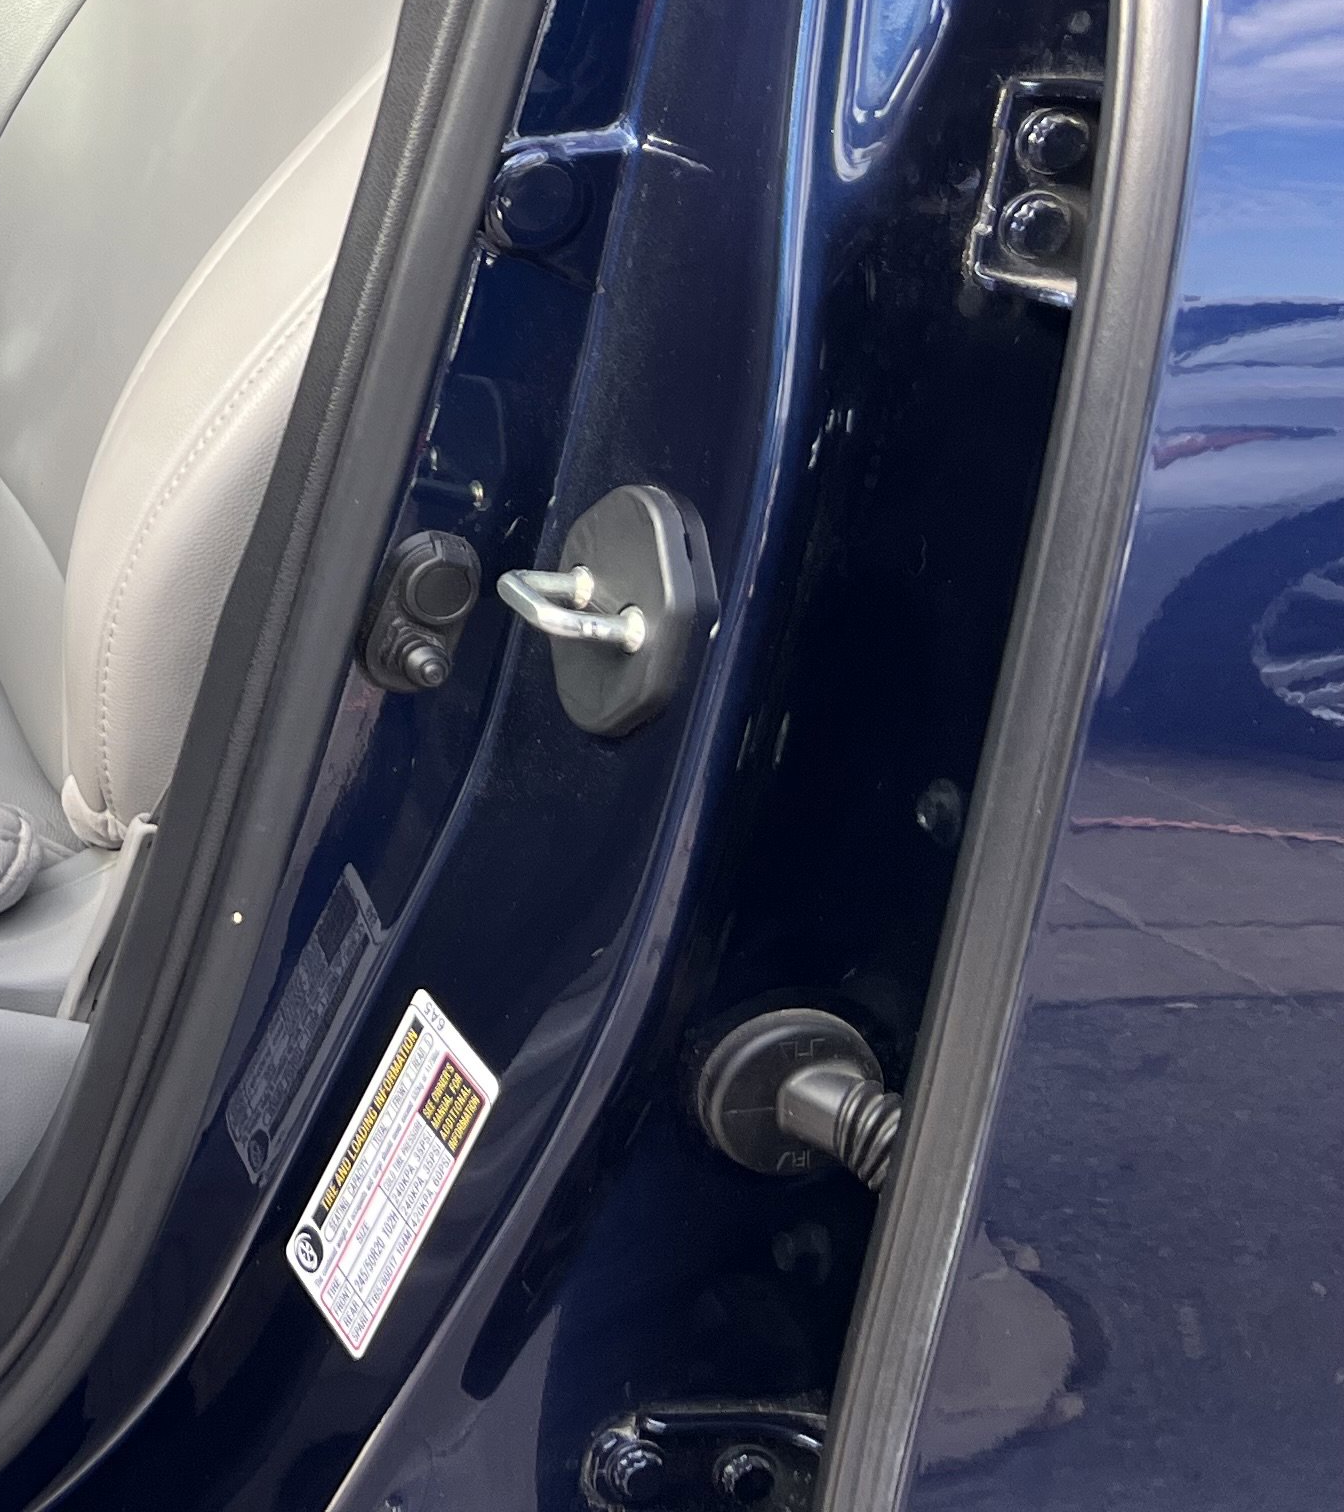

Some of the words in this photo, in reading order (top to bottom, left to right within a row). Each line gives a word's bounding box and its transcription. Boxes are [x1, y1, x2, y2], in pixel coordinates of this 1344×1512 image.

[320, 1179, 339, 1213] TIRE
[333, 1154, 352, 1188] AND
[346, 1103, 378, 1161] LOADING
[372, 1025, 418, 1110] INFORMATION
[421, 1098, 436, 1120] SEE
[430, 1061, 455, 1104] OWNER'S
[430, 1090, 453, 1130] MANUAL
[448, 1072, 463, 1094] FOR
[439, 1082, 471, 1141] ADDITIONAL
[447, 1093, 481, 1152] INFORMATION
[328, 1195, 349, 1233] SEATING
[346, 1155, 370, 1197] CAPACITY
[372, 1121, 387, 1146] TOTAL
[391, 1081, 408, 1109] FRONT
[411, 1045, 426, 1070] REAR
[326, 1274, 341, 1300] TIRE
[355, 1219, 370, 1245] SIZE
[333, 1284, 351, 1317] FRONT
[413, 1129, 432, 1162] 35PSI
[343, 1298, 359, 1328] REAR
[422, 1140, 441, 1174] 35PSI
[350, 1310, 369, 1343] SPARE
[395, 1228, 412, 1257] 104M
[432, 1153, 451, 1187] 60PSI
[353, 1235, 385, 1293] 245/50R20
[381, 1208, 399, 1240] 102H
